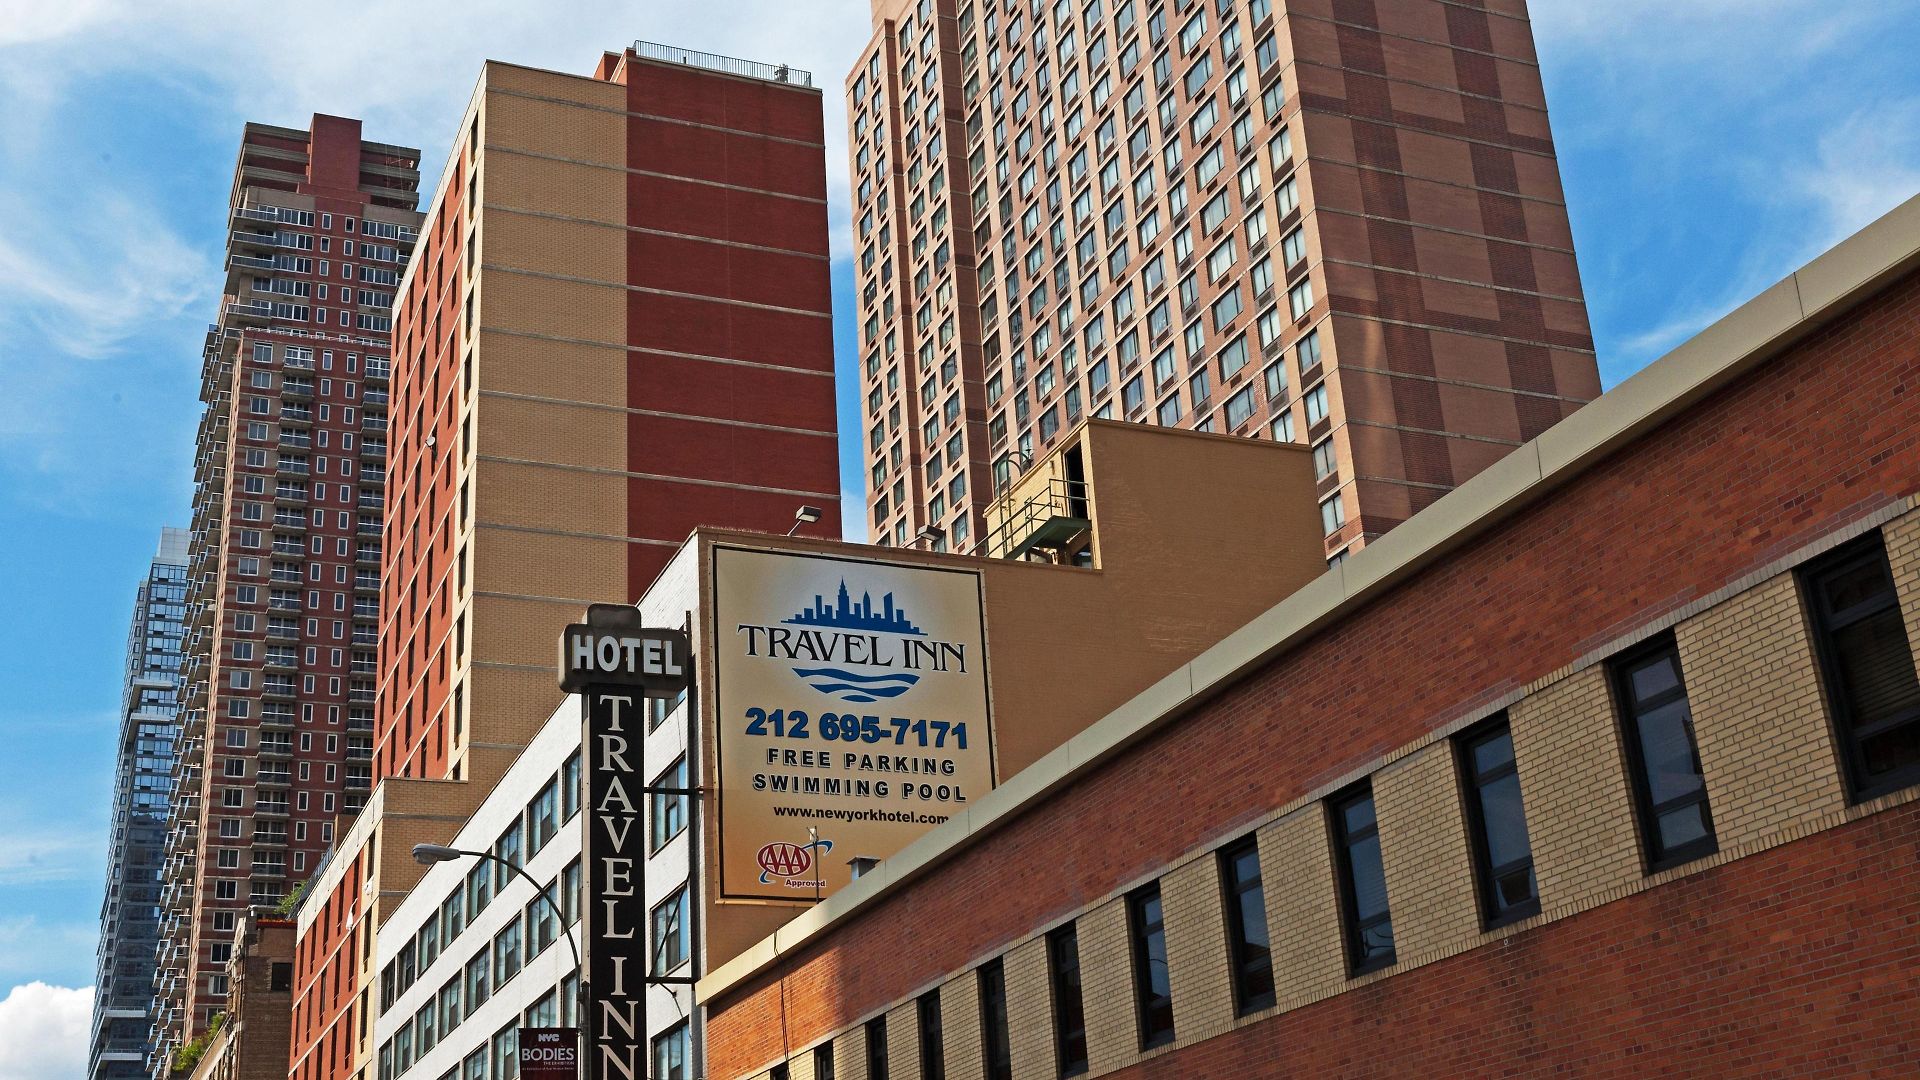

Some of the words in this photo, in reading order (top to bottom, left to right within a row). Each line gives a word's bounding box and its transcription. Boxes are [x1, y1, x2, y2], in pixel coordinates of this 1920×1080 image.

[572, 634, 682, 675] HOTEL
[737, 624, 894, 667] TRAVEL
[901, 638, 967, 673] INN
[745, 707, 809, 738] 212
[819, 713, 967, 749] 695-7171
[767, 748, 831, 768] FREE
[845, 753, 955, 774] PARKING
[753, 774, 889, 797] SWIMMING
[902, 782, 966, 801] POOL
[597, 695, 638, 939] TRAVEL
[774, 806, 949, 825] www.newyorkhotel.com
[761, 843, 808, 876] AAA
[598, 956, 639, 1080] INN
[521, 1047, 575, 1061] BODIES
[538, 1033, 560, 1042] NYC
